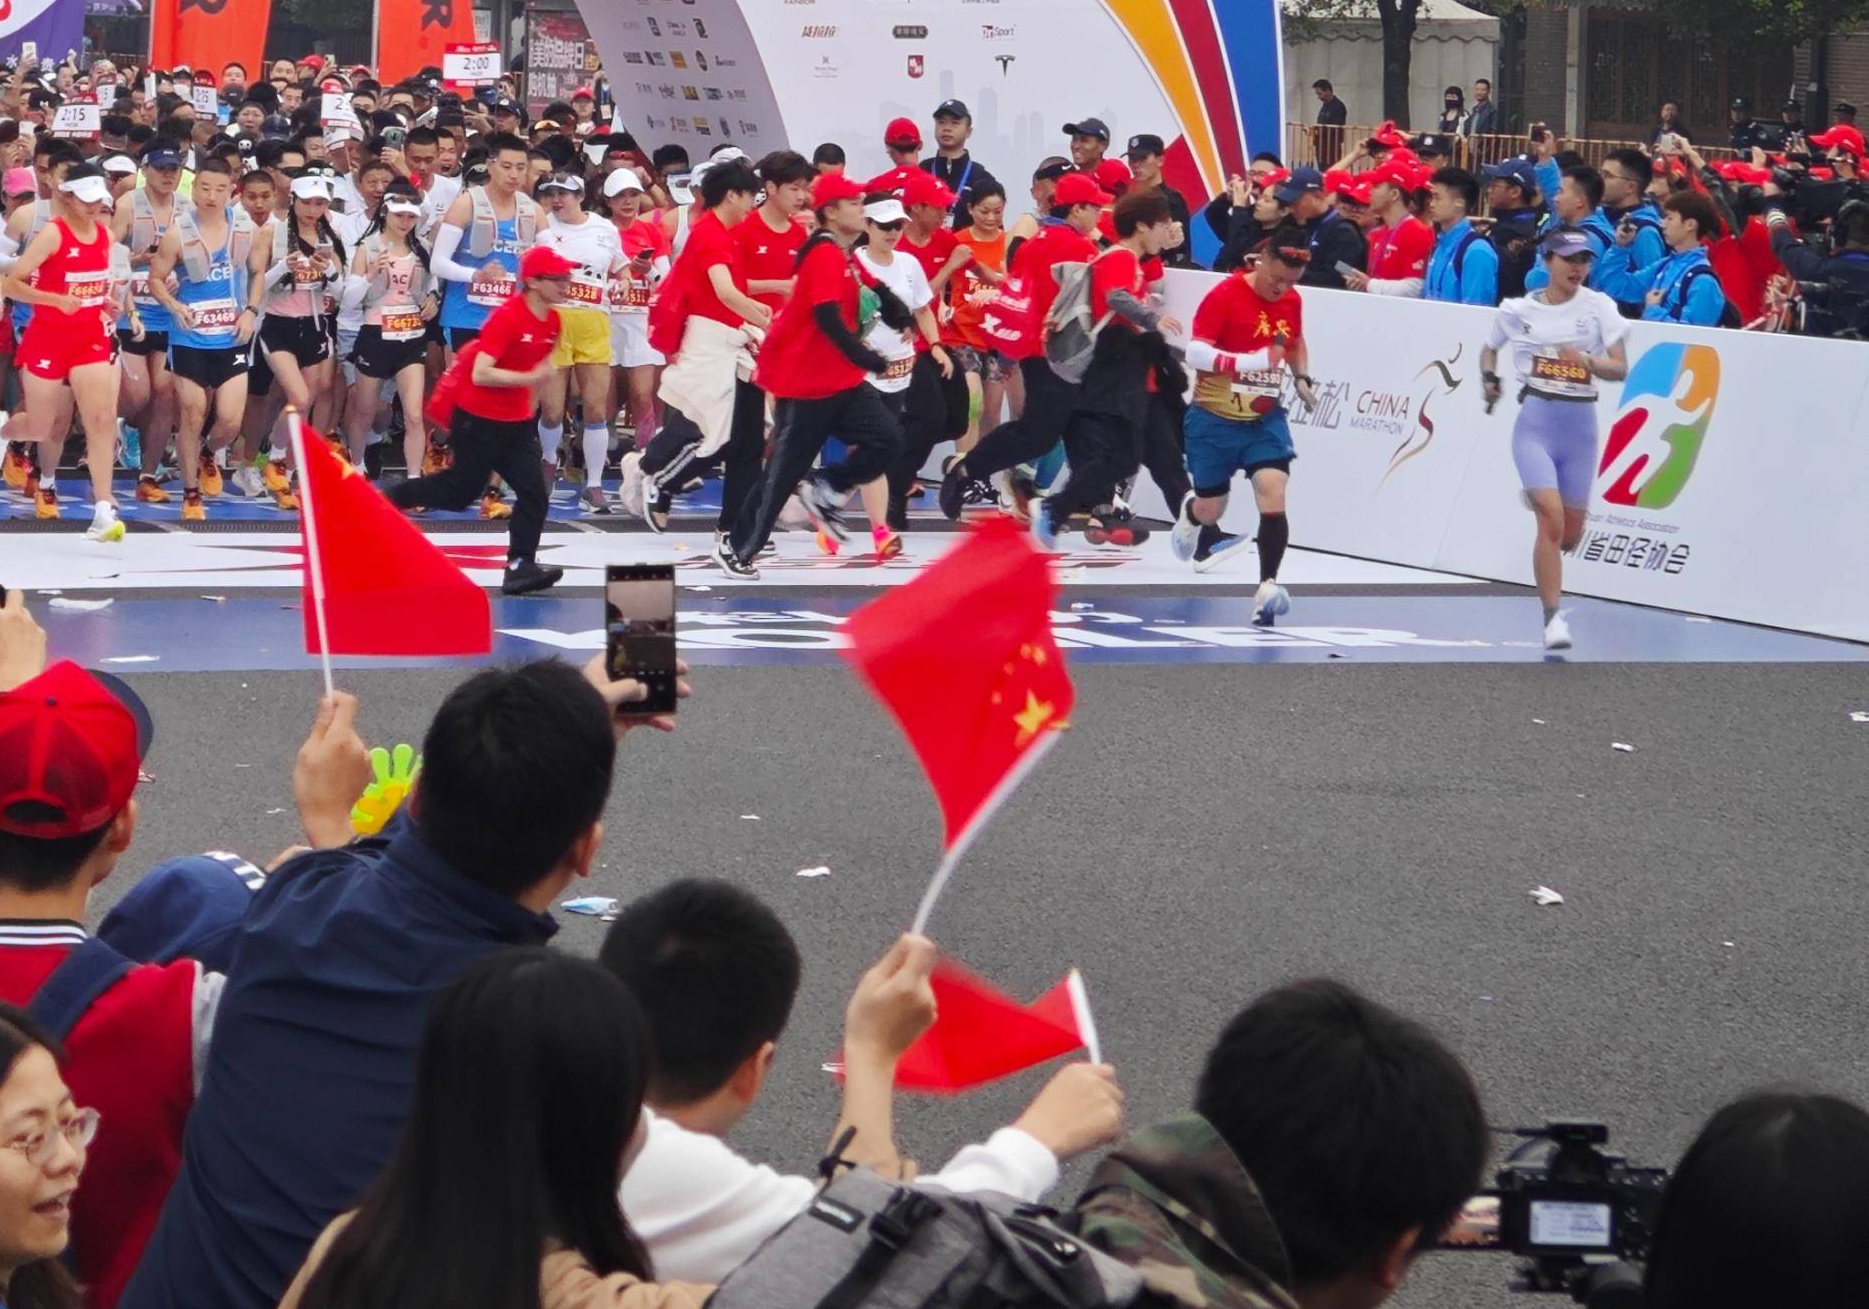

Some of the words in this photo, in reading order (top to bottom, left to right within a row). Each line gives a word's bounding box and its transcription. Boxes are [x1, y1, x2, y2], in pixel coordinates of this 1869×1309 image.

[463, 56, 490, 71] 2:00
[1356, 389, 1411, 419] CHINA
[1348, 416, 1406, 436] MARATHON
